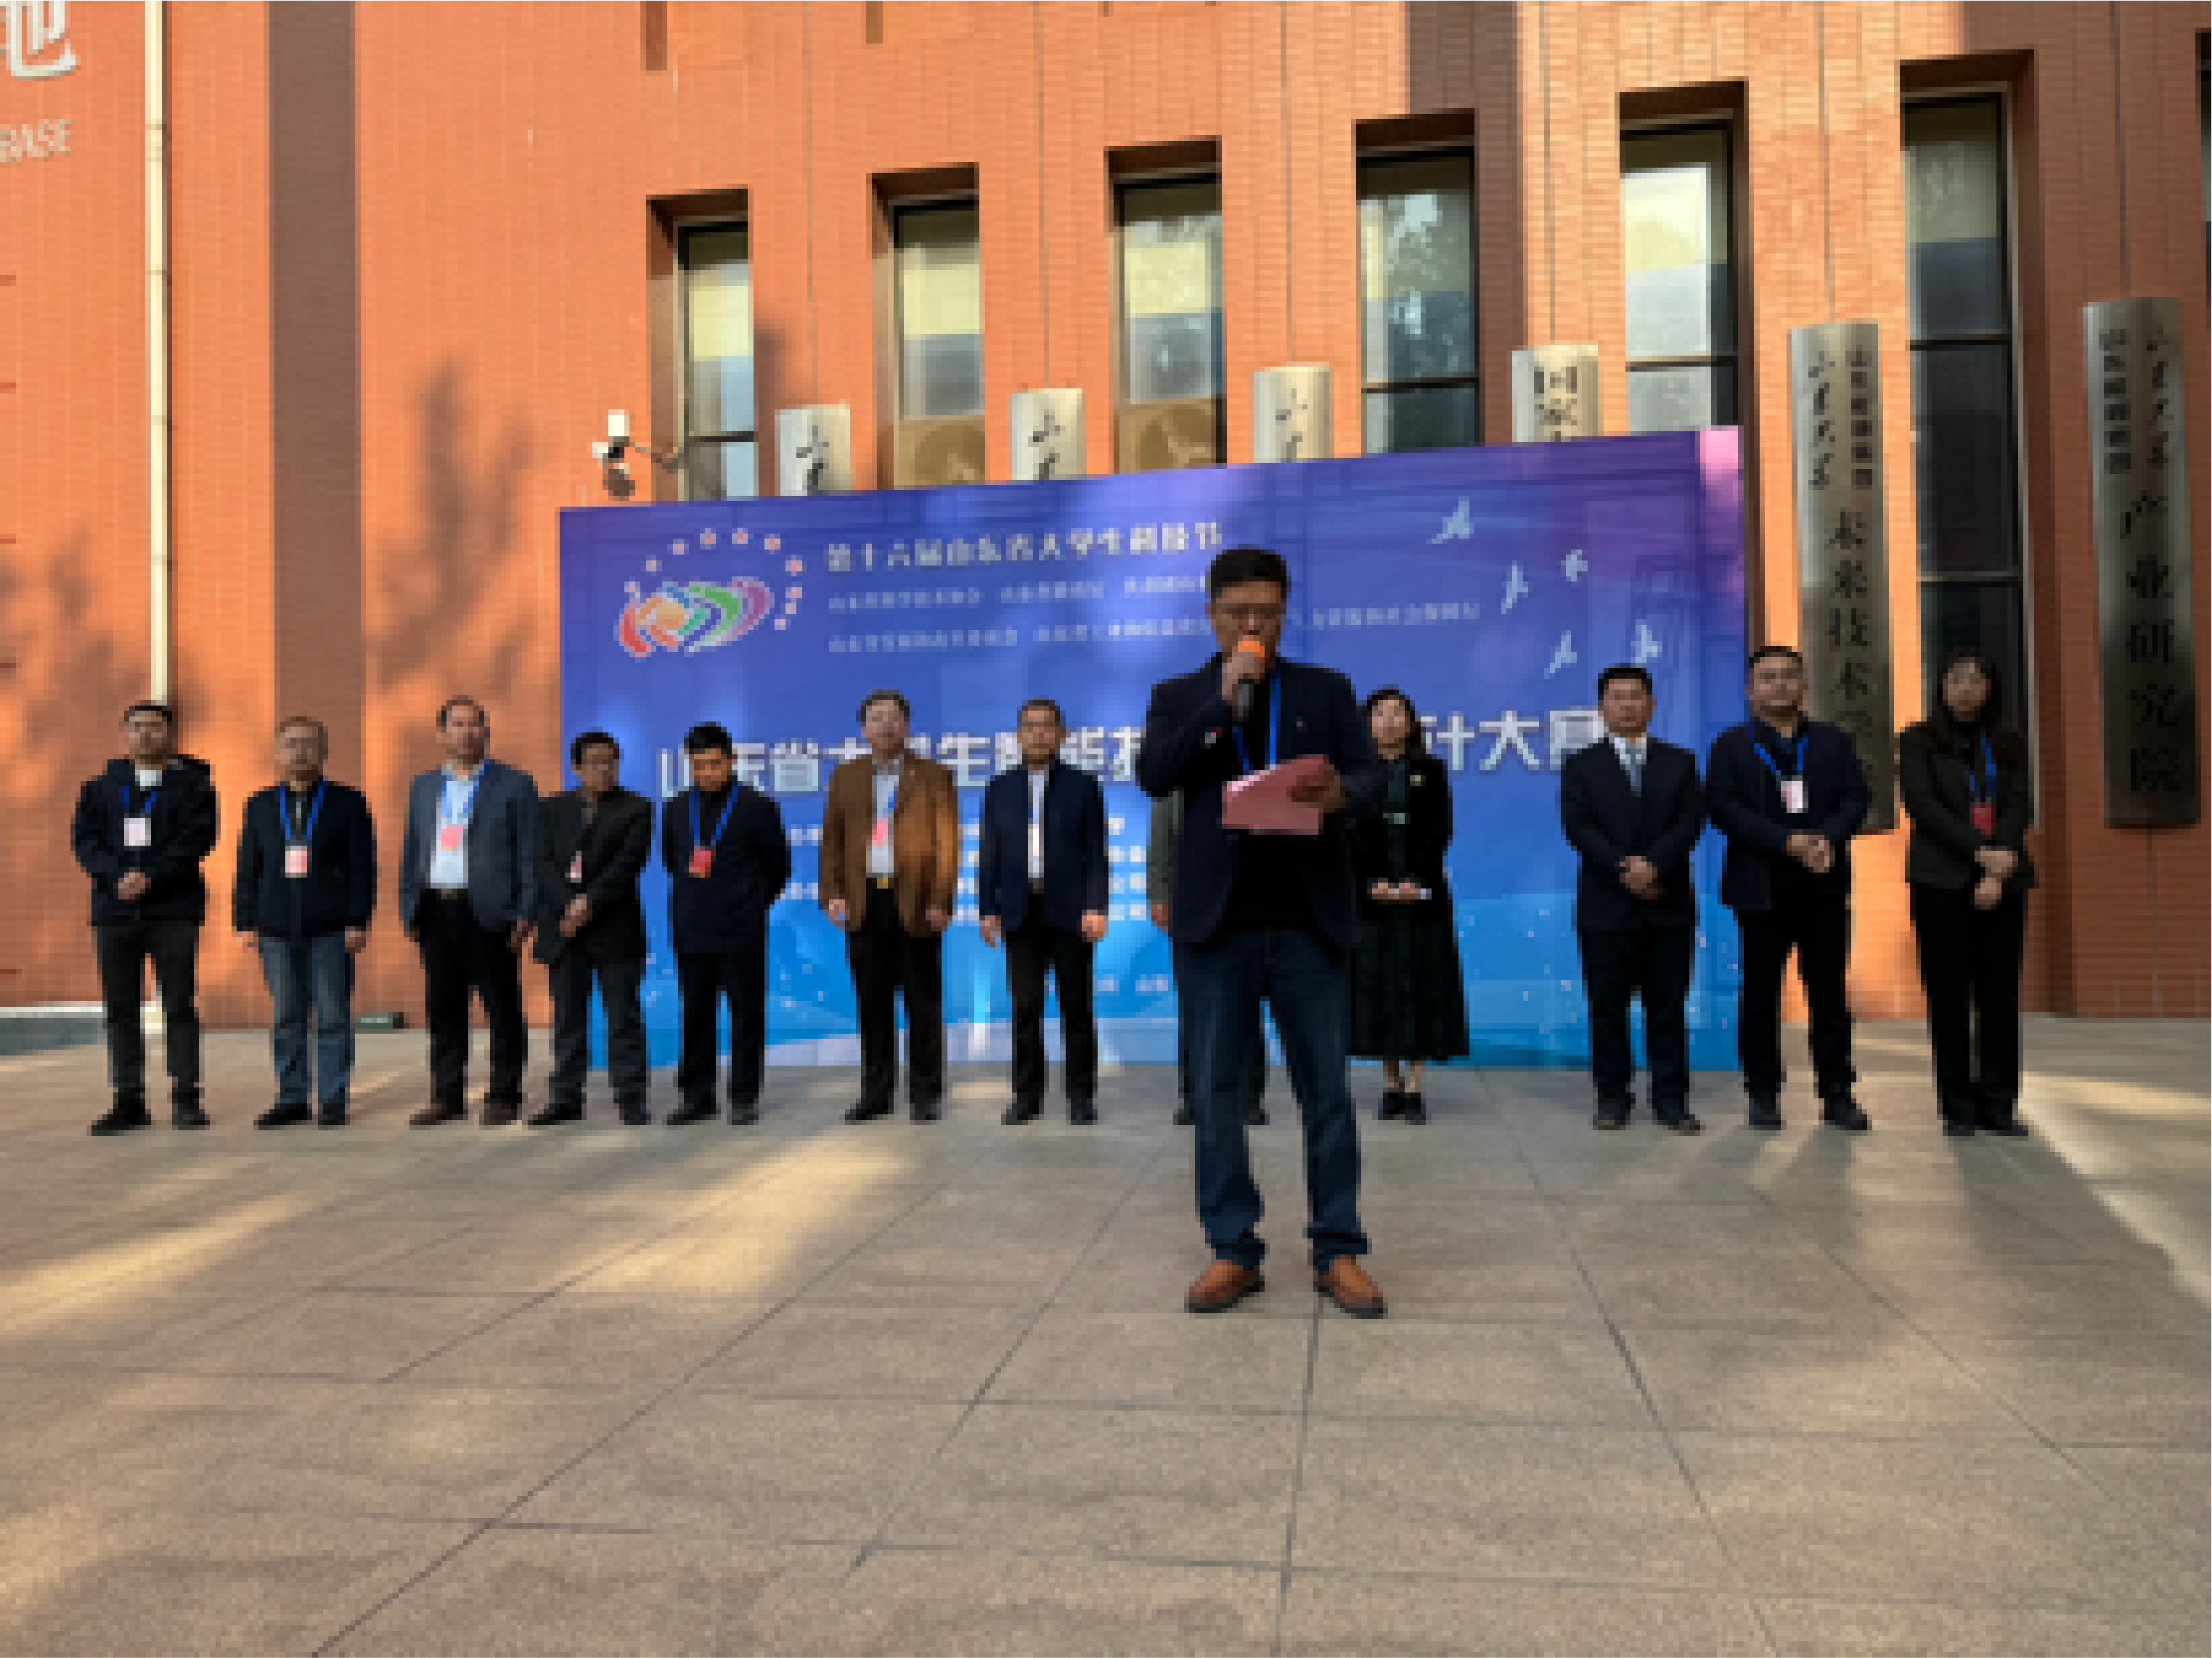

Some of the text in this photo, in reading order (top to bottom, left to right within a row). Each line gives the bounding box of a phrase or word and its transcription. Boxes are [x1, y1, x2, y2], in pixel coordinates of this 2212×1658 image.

[1529, 369, 1575, 444] 国家
[1821, 512, 1873, 783] 未来技术
